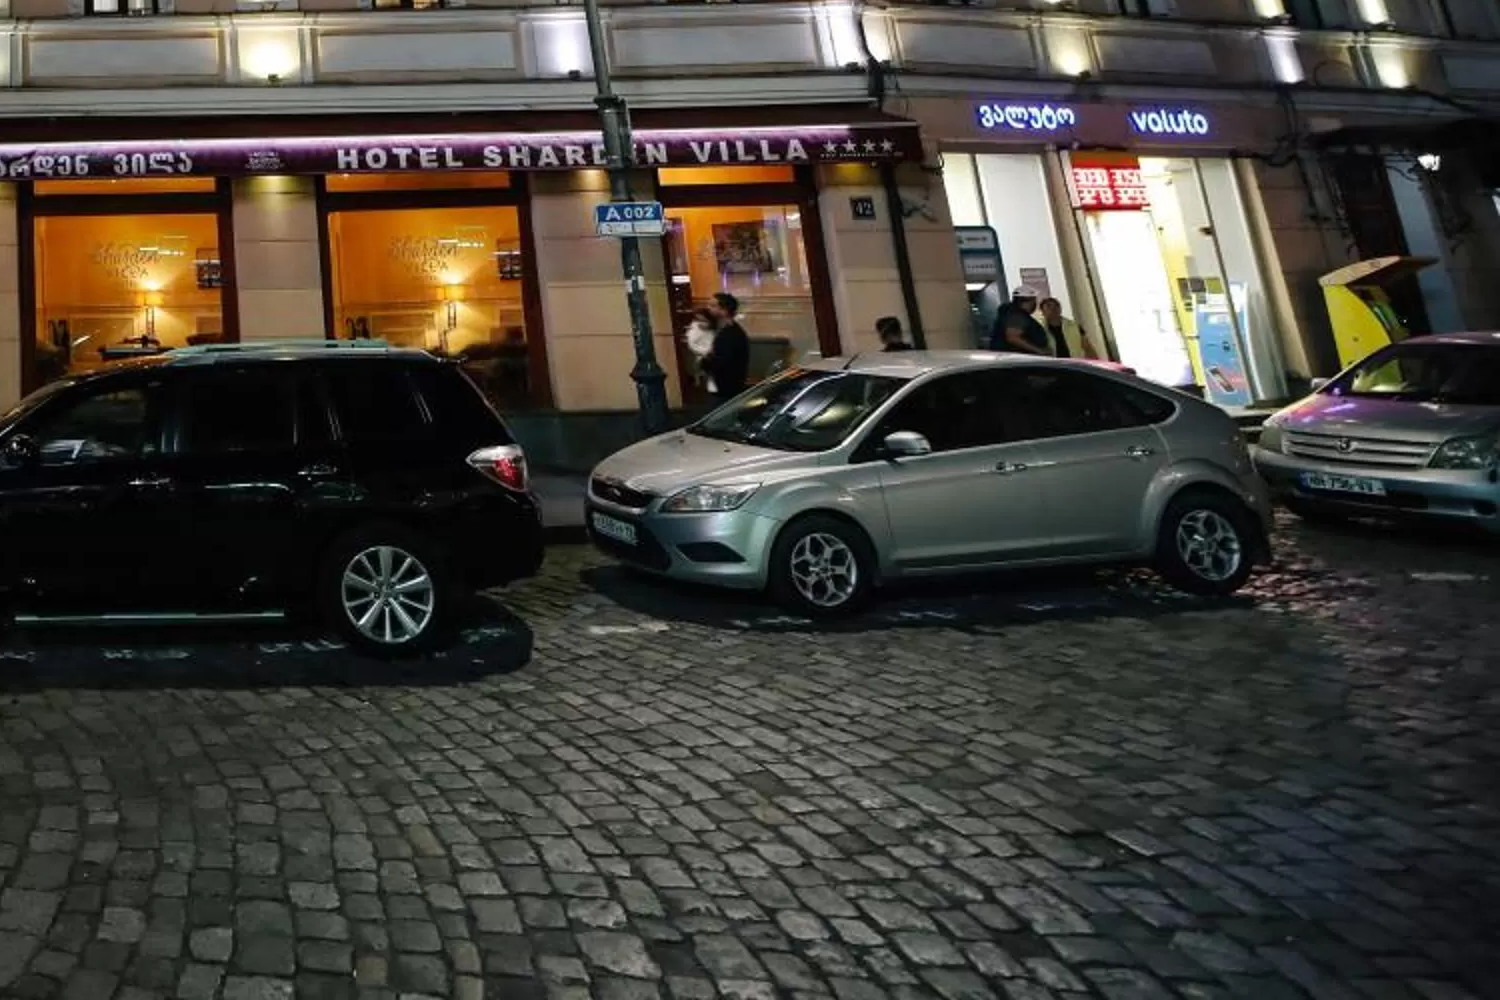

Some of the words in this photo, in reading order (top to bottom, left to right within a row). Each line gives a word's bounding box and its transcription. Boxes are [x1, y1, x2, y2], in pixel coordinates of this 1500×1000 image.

[978, 103, 1076, 130] ვალუტო
[1131, 109, 1209, 135] valuto
[112, 150, 195, 175] ვილა
[336, 146, 464, 170] HOTEL
[482, 142, 669, 168] SHARDN
[689, 137, 809, 163] VILLA
[605, 206, 621, 221] A
[623, 205, 655, 219] 002
